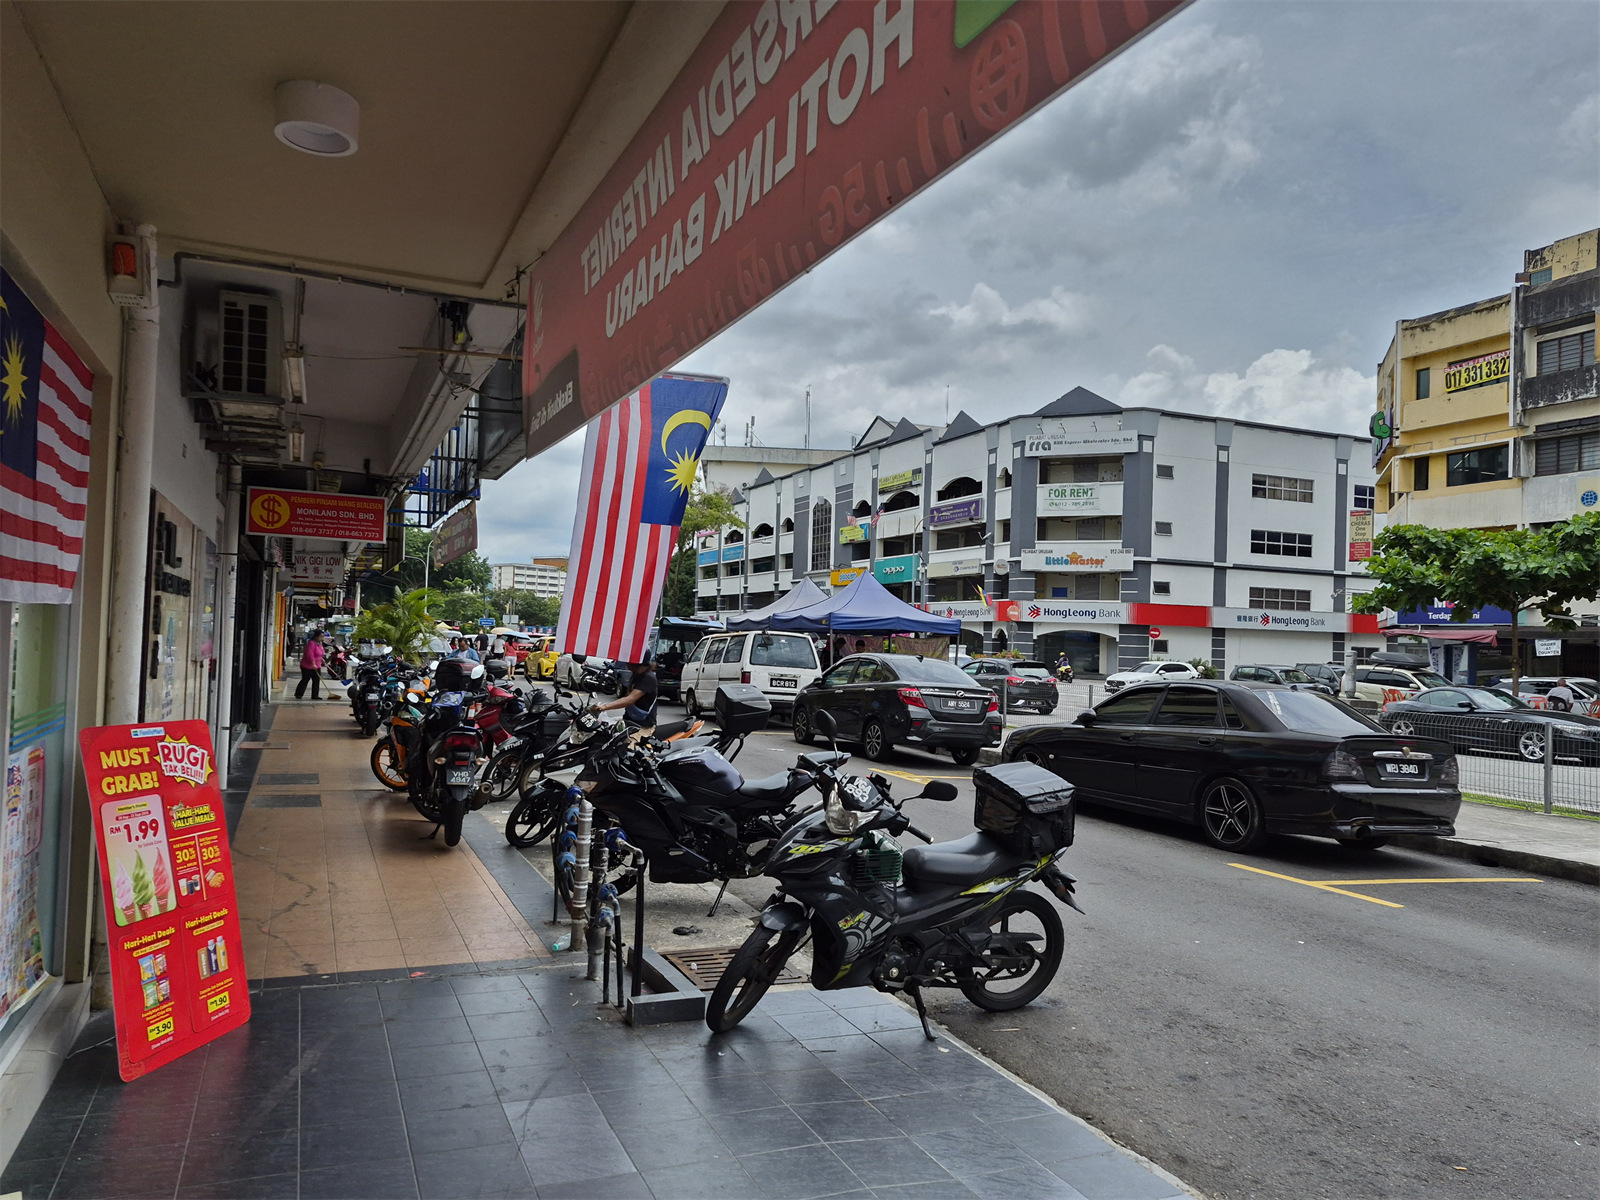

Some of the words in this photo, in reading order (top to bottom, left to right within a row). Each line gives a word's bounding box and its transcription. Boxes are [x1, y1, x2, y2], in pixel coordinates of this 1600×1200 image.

[1445, 369, 1462, 389] 017
[1464, 364, 1483, 384] 331
[1029, 441, 1051, 451] rra
[1048, 488, 1067, 498] FOR
[1070, 487, 1095, 498] RENT
[291, 496, 315, 505] PEMBERI
[316, 498, 337, 506] PINJAM
[338, 499, 355, 508] WANG
[356, 501, 383, 510] BERLESEN
[297, 507, 338, 517] MONILAND
[339, 510, 357, 519] SDN.
[358, 512, 377, 521] BHD.
[309, 556, 323, 565] GIGI
[326, 557, 341, 566] LOW
[883, 565, 905, 575] oppo
[954, 608, 979, 618] HongLeong
[1043, 608, 1097, 619] HongLeong
[1098, 608, 1121, 618] Bank
[1271, 616, 1309, 627] HongLeong
[1310, 617, 1325, 626] Bank
[100, 747, 151, 769] MUST
[160, 744, 206, 770] RUGI
[164, 764, 178, 774] TAK
[1399, 764, 1419, 774] 3840
[101, 771, 160, 795] GRAB!
[853, 777, 872, 795] VGA
[176, 805, 210, 818] HARI-HARI
[172, 818, 194, 829] VALUE
[195, 812, 215, 824] MEALS
[109, 826, 121, 835] RM
[123, 818, 159, 843] 1.99
[788, 844, 827, 854] 46
[185, 913, 214, 929] Hari-Hari
[213, 908, 229, 918] Deals
[124, 931, 157, 950] Hari-Hari
[157, 926, 176, 938] Deals
[214, 995, 227, 1007] 1.90
[155, 1021, 172, 1035] 3.90
